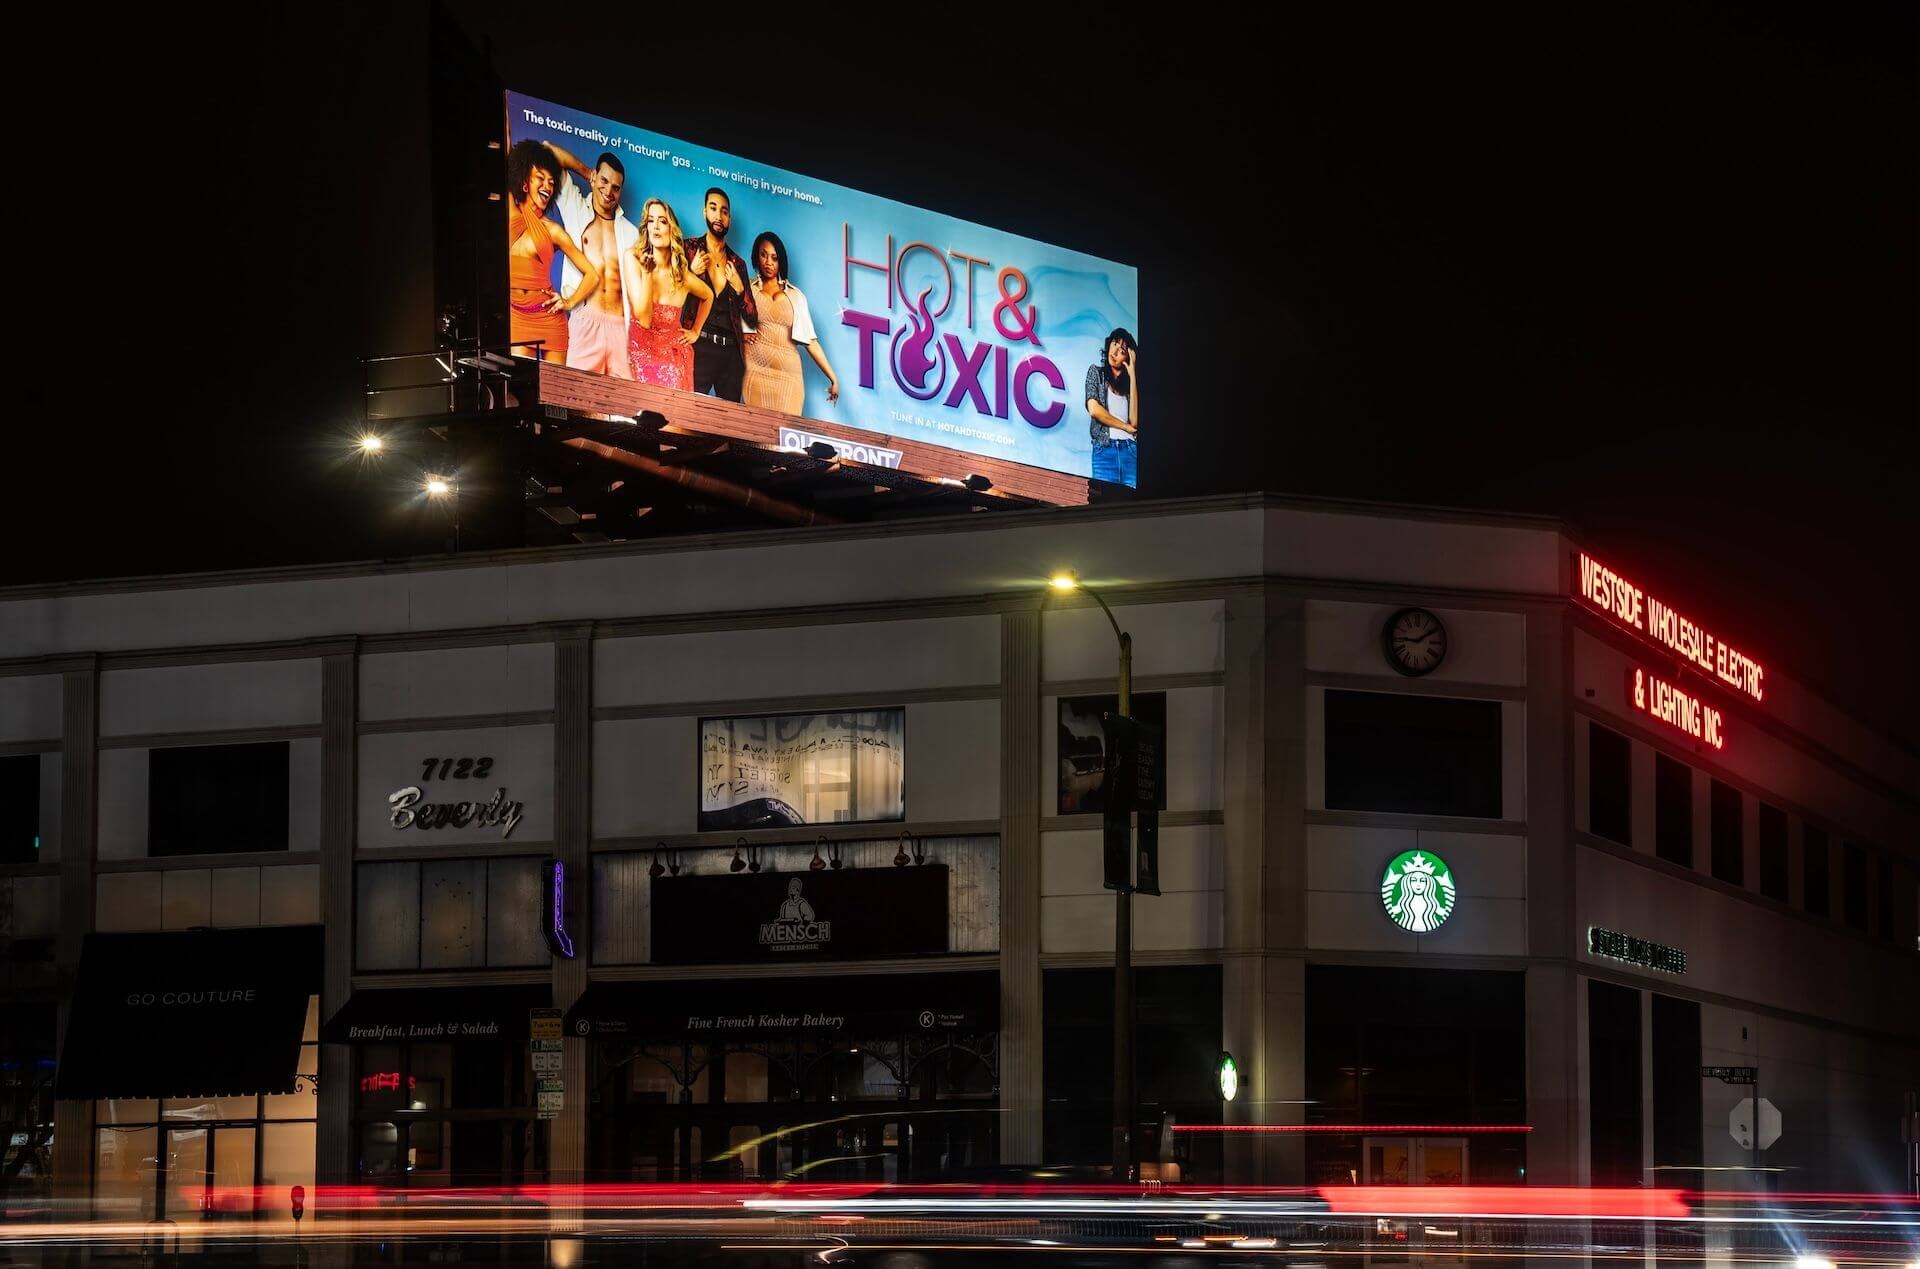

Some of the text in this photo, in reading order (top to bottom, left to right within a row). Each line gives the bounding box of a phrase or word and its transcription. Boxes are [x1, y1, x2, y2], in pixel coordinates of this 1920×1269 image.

[523, 109, 544, 125] The
[546, 117, 573, 134] toxic
[574, 127, 609, 146] reality
[610, 136, 621, 148] of
[671, 155, 691, 167] gas
[708, 165, 729, 179] now
[731, 172, 759, 189] airing
[760, 178, 770, 190] in
[771, 183, 792, 197] your
[794, 187, 823, 206] home.
[842, 222, 990, 329] HOT
[841, 307, 1066, 429] TOXIC
[890, 411, 1016, 446] TUNE IN AT HOTANDTOXIC.COM
[1580, 552, 1764, 701] WESTSIDE WHOLESALE ELECTRIC
[1634, 668, 1723, 750] & LIGHTING INC
[421, 756, 495, 782] 7122
[388, 786, 525, 839] Beverly
[760, 922, 831, 942] MENSCH
[127, 989, 256, 1006] GO COUTURE
[349, 1020, 499, 1041] Breakfast, Lunch & Salads
[687, 1011, 845, 1030] Fine French Kosher Bakery
